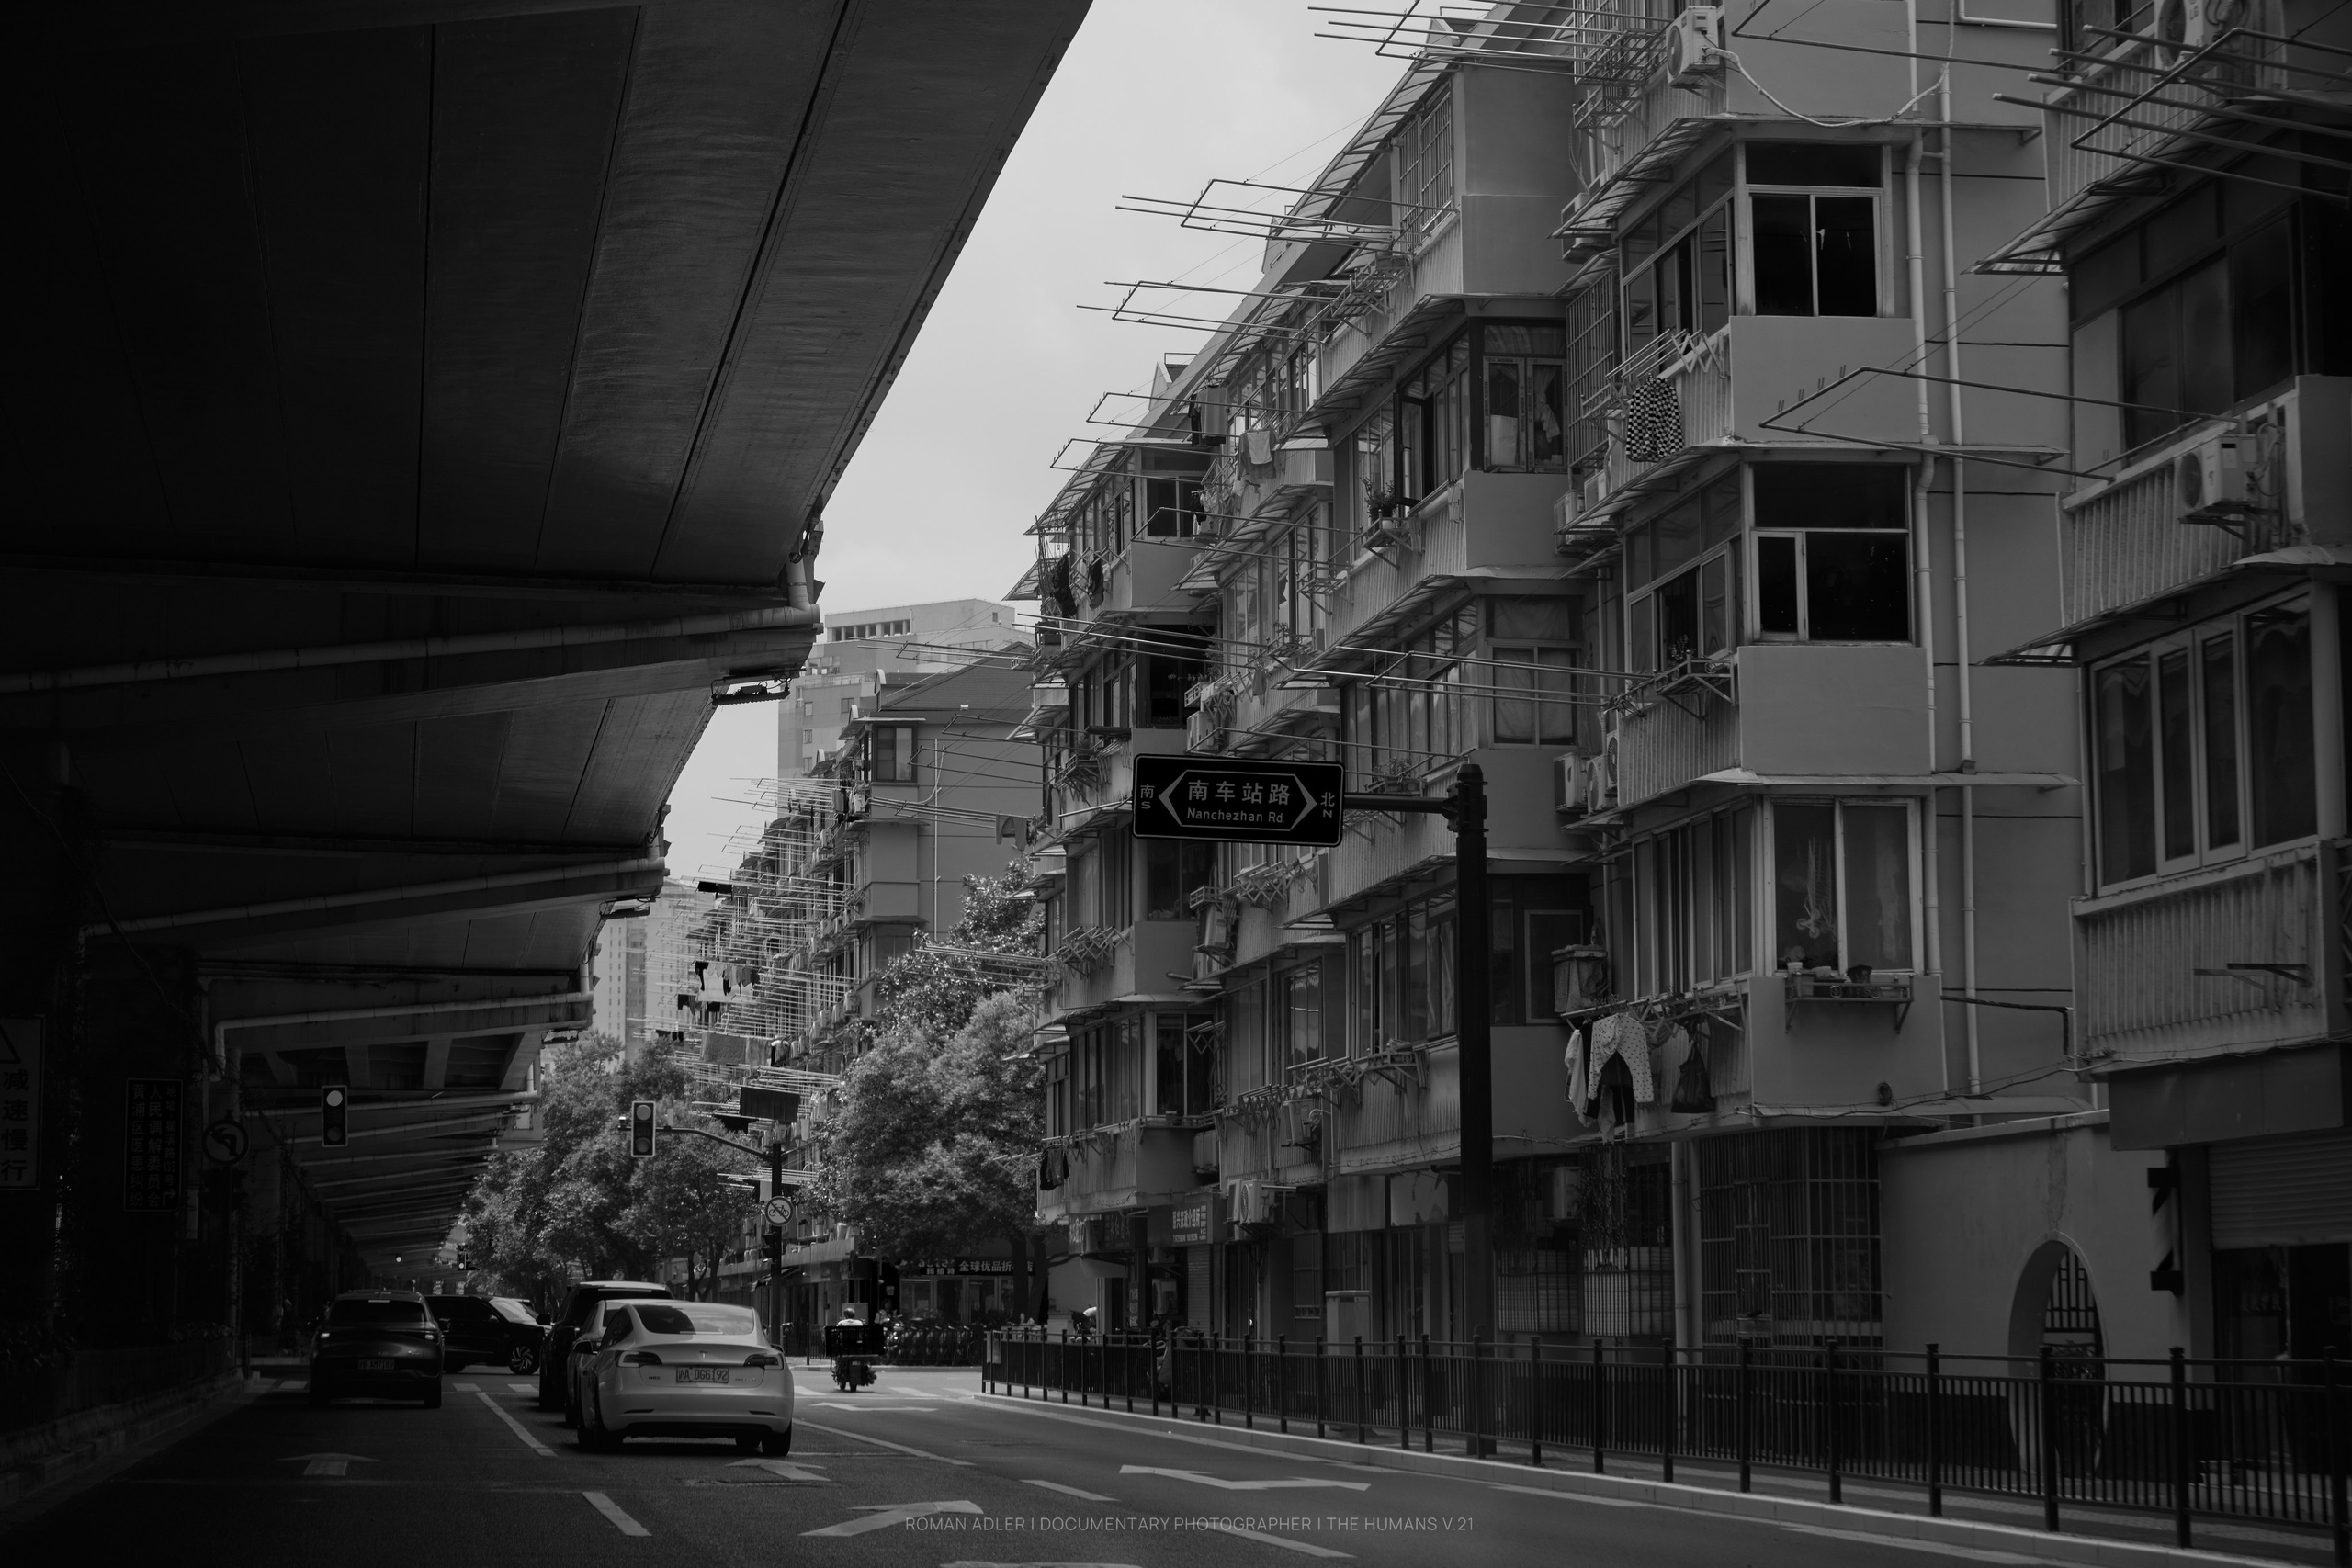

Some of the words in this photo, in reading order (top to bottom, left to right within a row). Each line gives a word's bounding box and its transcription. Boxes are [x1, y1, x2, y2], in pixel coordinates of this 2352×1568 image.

[1140, 784, 1155, 799] 南
[1187, 780, 1290, 806] 南车站路
[1141, 801, 1151, 810] S
[1320, 792, 1335, 807] 北
[1187, 807, 1263, 823] Nanchezhan
[1268, 811, 1285, 824] Rd.
[1323, 809, 1332, 818] N
[1, 1068, 30, 1182] 减速慢行
[130, 1083, 147, 1208] 黄浦区医患纠纷
[147, 1083, 163, 1208] 人民调解委员会
[958, 1260, 1034, 1273] 全球优品折店
[694, 1369, 728, 1381] DG6192
